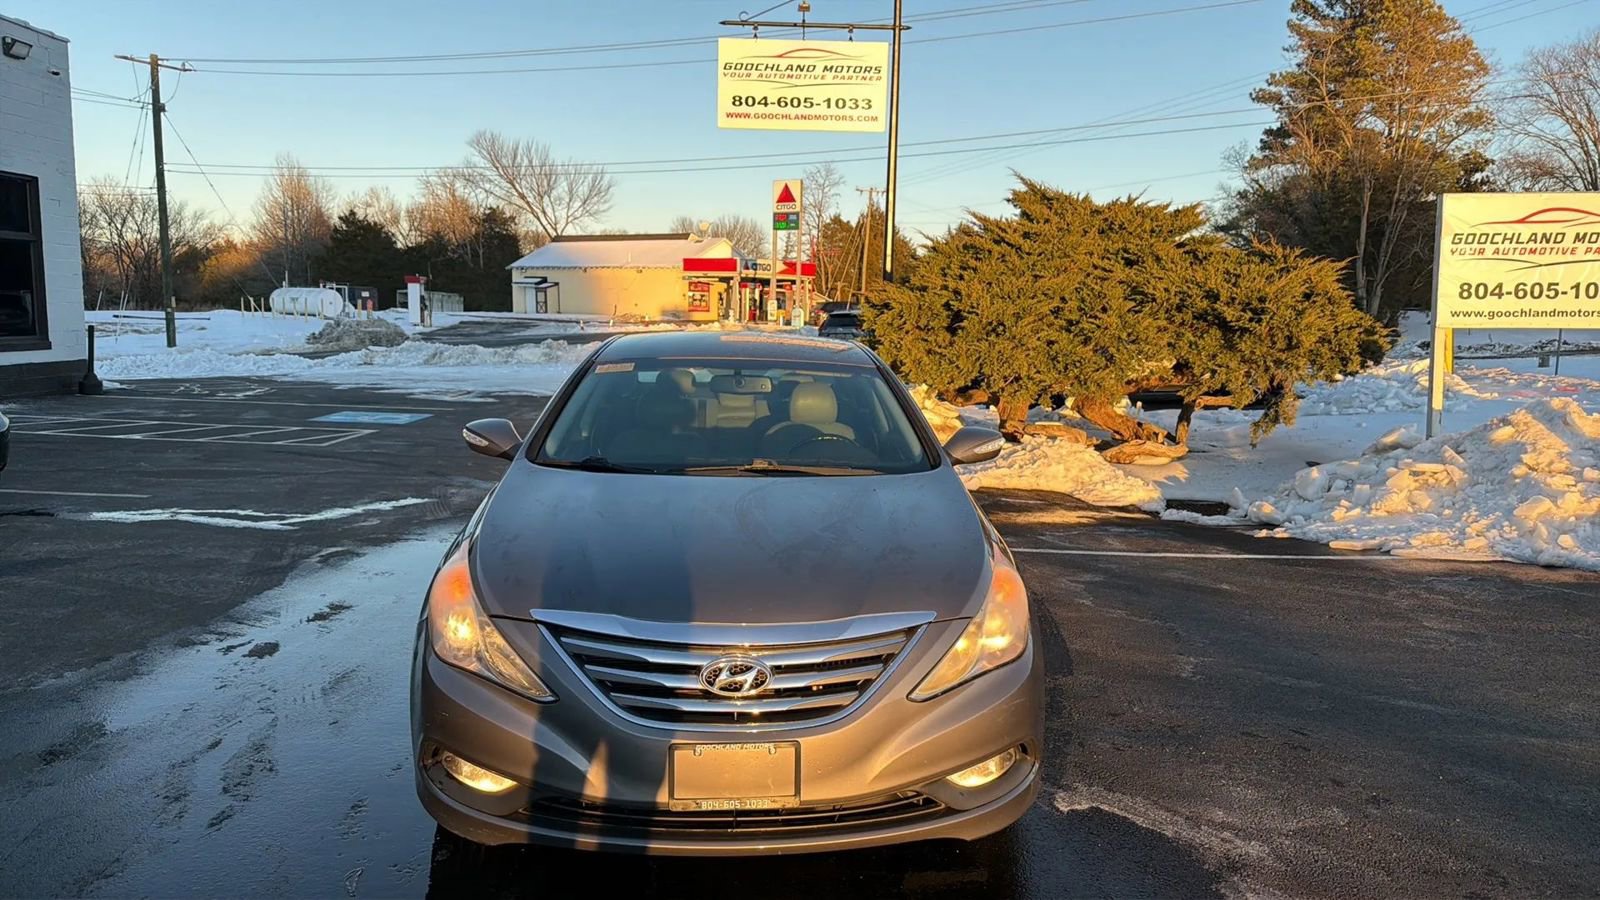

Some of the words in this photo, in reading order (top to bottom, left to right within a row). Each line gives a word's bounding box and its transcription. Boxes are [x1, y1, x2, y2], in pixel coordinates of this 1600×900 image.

[723, 62, 816, 73] GOOCHLAND
[822, 64, 882, 74] MOTORS
[757, 72, 827, 80] AUTOMOTIVE
[731, 95, 873, 110] 804-605-1033
[725, 111, 878, 122] WWW.GOOCHLANDMOTORS.COM
[1451, 232, 1566, 245] GOOCHLAND
[1573, 232, 1600, 244] MO
[1450, 247, 1486, 256] YOUR
[1492, 247, 1578, 255] AUTOMOTIVE
[1458, 282, 1600, 300] 804-605-10
[695, 743, 741, 751] GOOCHLAND
[743, 742, 775, 750] MOTORS
[701, 799, 768, 809] 804-605-1033
